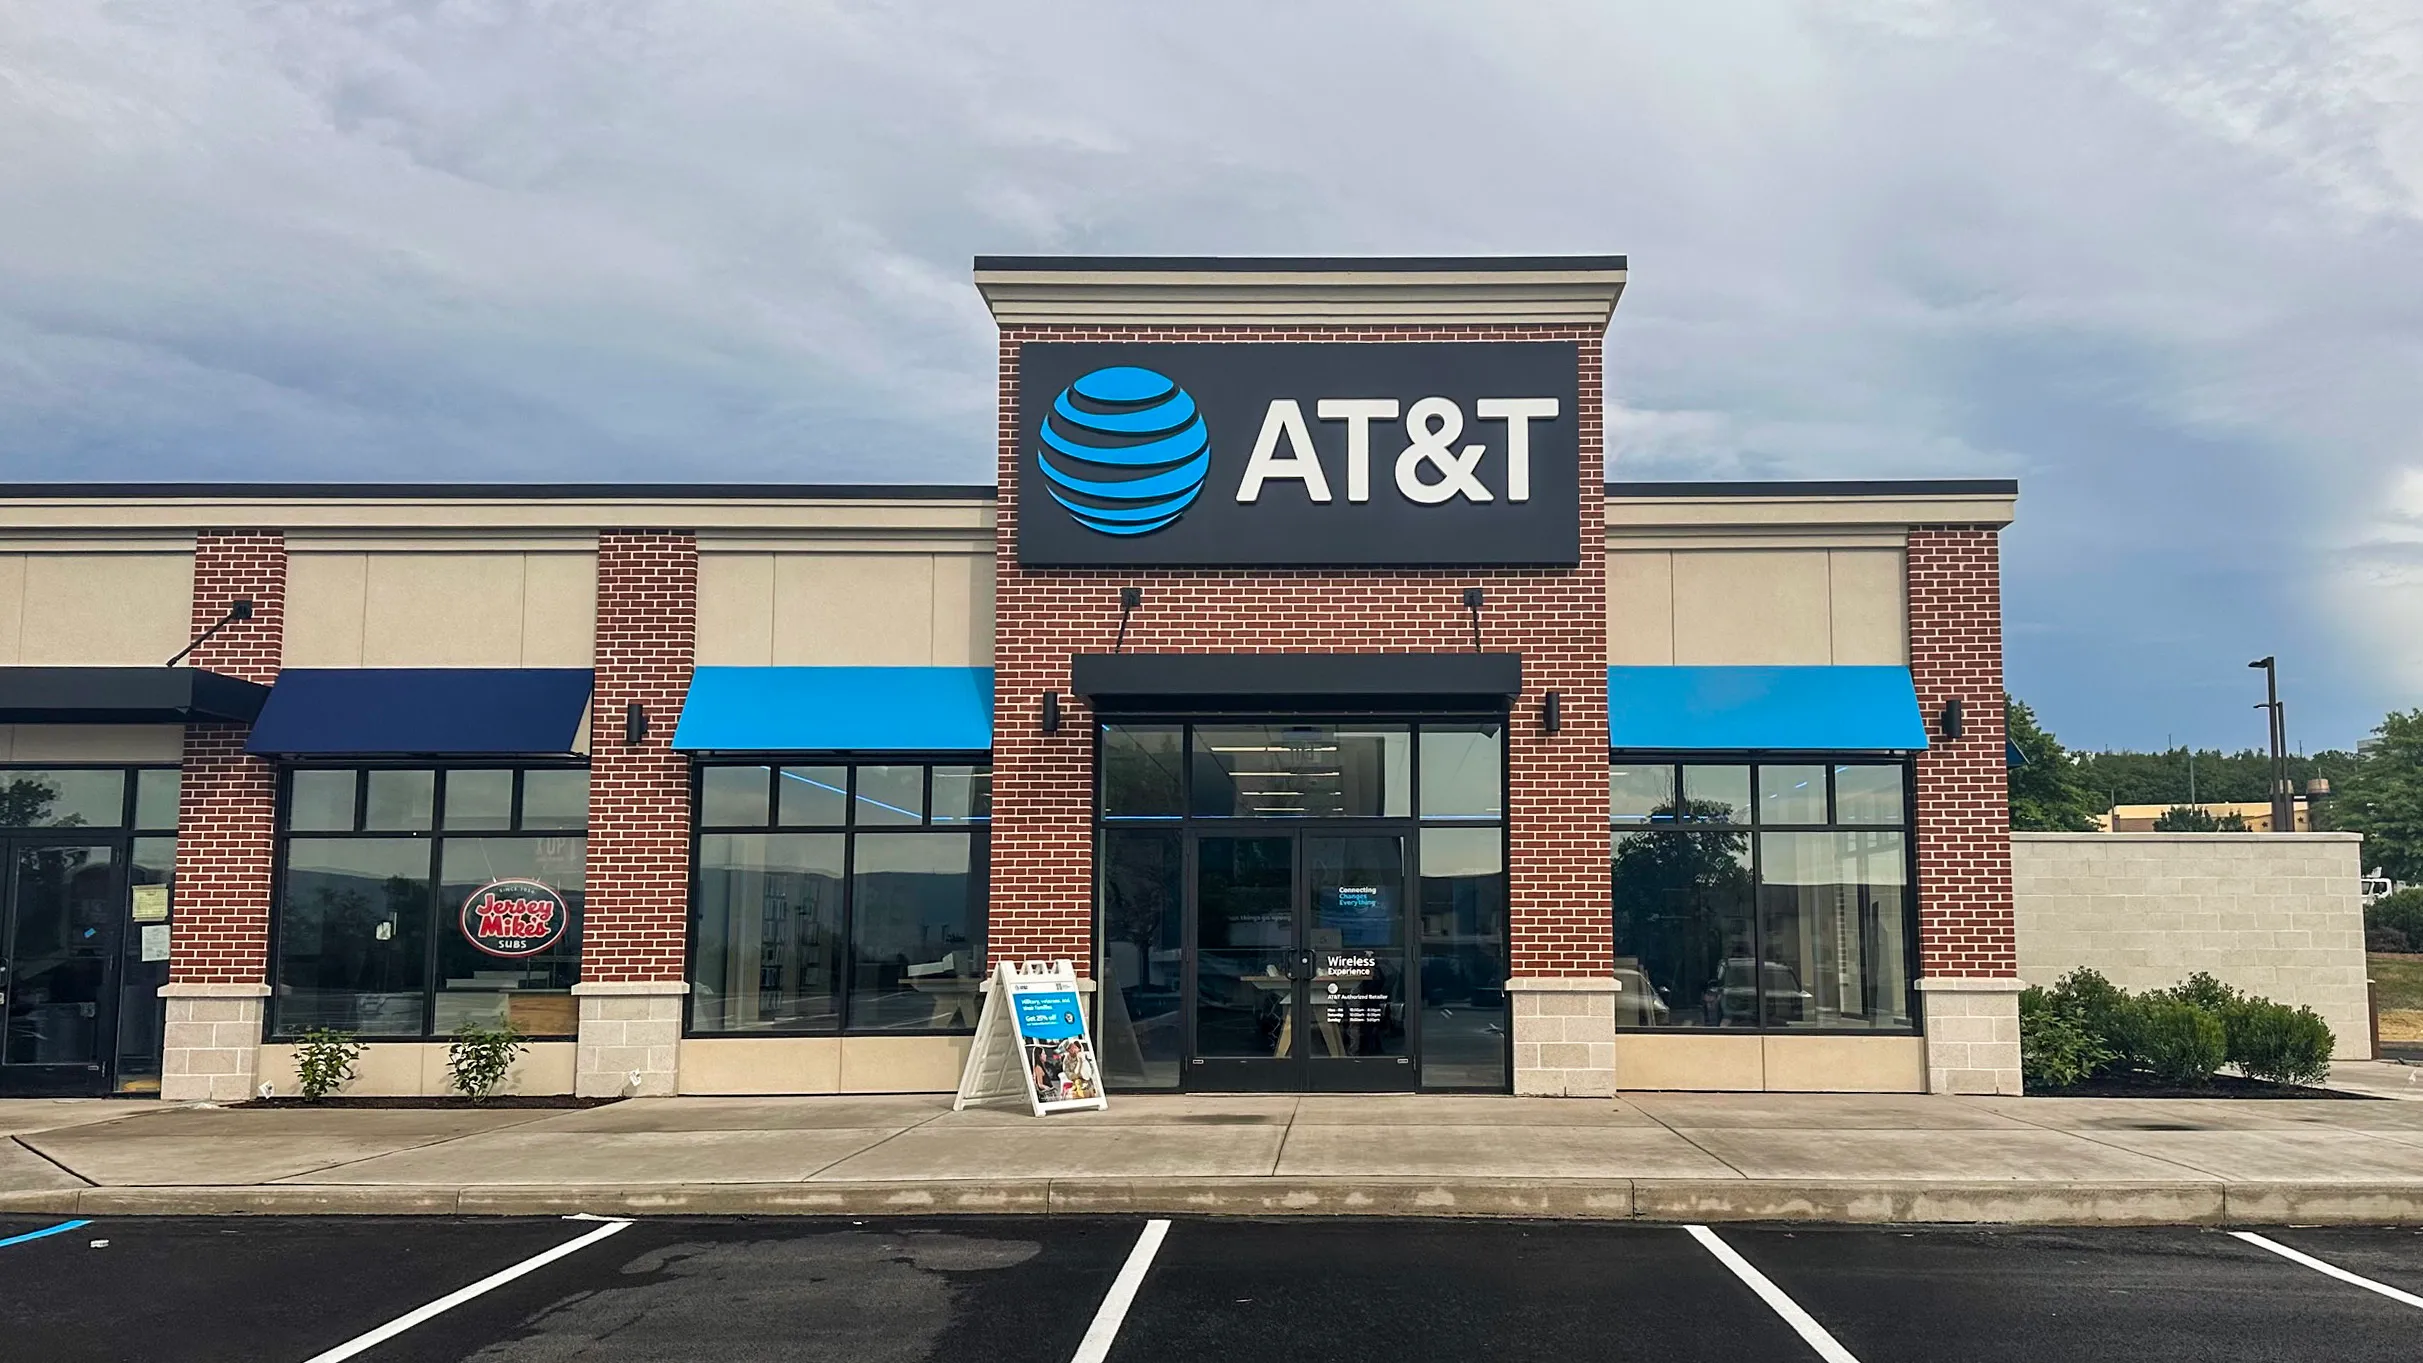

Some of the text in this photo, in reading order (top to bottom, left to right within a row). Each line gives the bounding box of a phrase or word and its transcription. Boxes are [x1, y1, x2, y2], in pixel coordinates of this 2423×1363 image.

[1236, 396, 1560, 504] AT&T
[1339, 886, 1377, 895] Connecting
[475, 893, 555, 920] Jersey
[478, 915, 552, 938] Mike's
[498, 940, 527, 949] SUBS
[1327, 955, 1376, 967] Wireless
[1327, 968, 1371, 976] Experience
